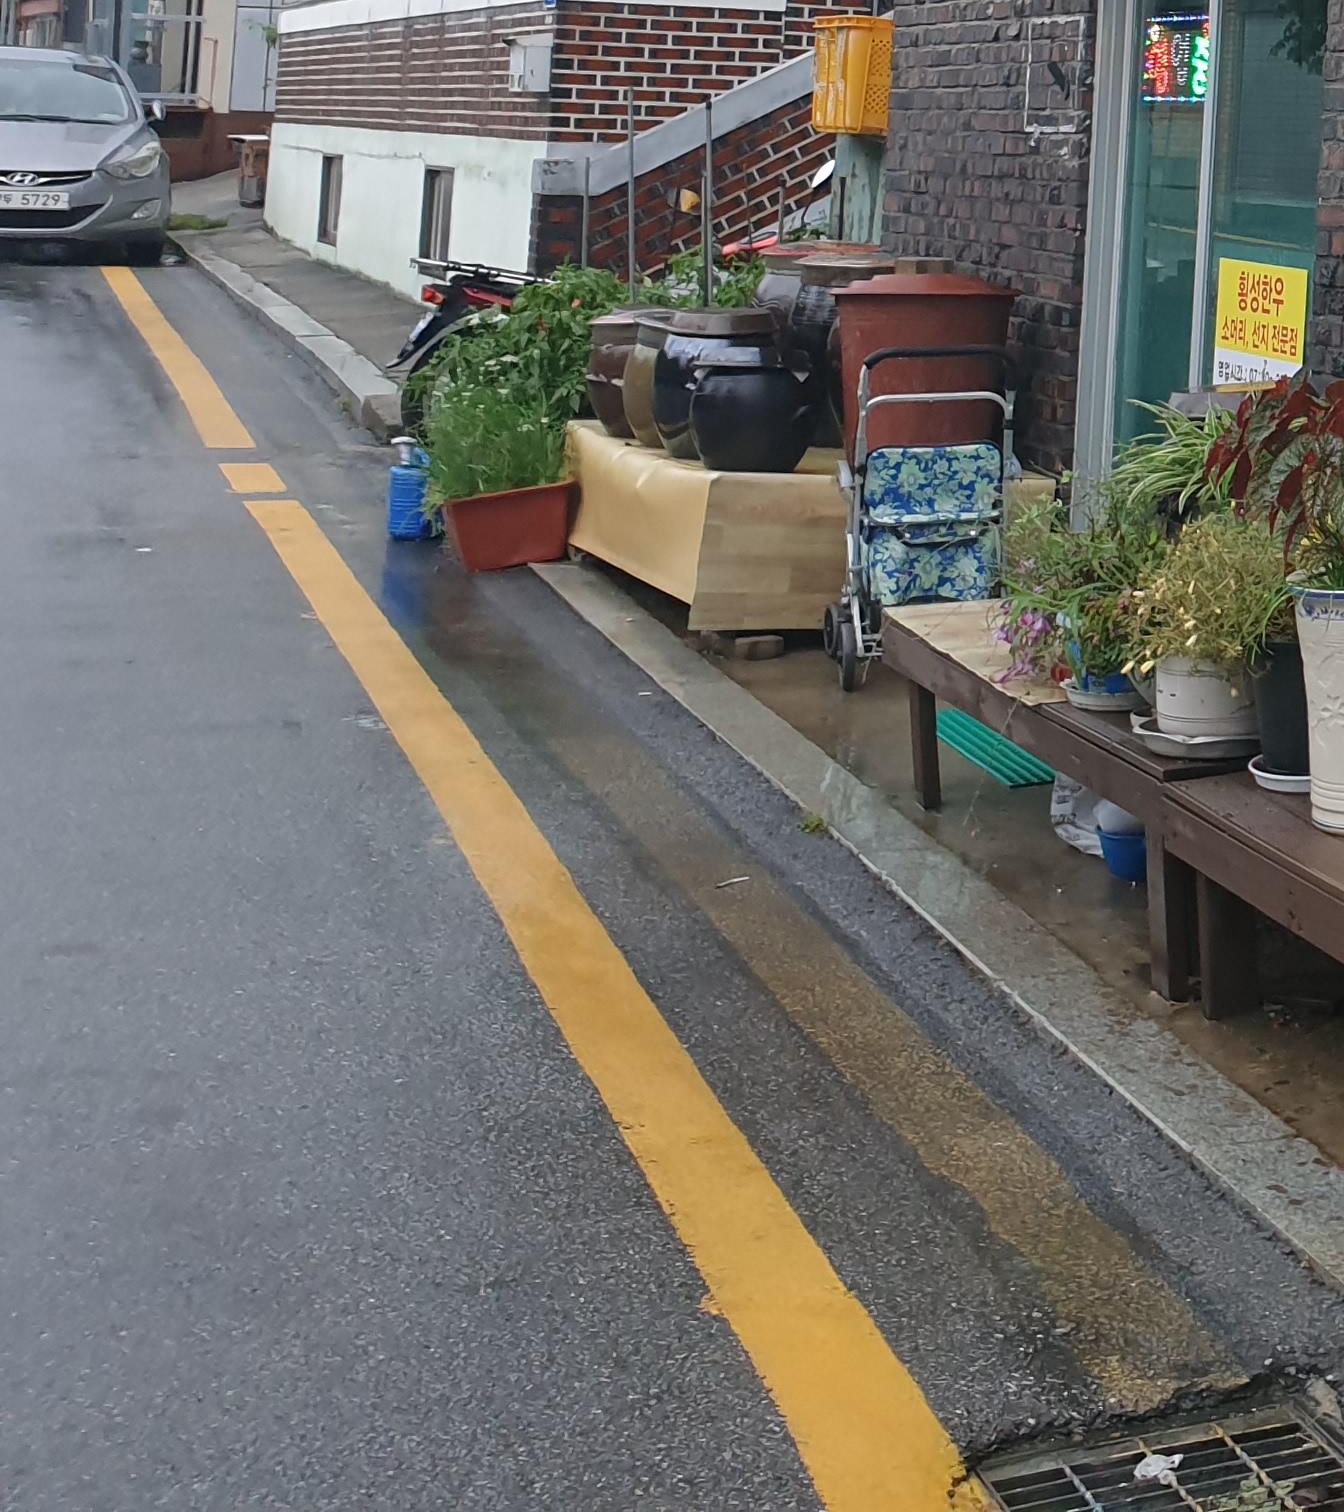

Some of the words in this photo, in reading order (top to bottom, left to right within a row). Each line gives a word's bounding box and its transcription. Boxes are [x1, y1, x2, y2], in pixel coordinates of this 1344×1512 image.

[21, 194, 61, 206] 5729
[1238, 270, 1284, 317] 횡성한우
[1221, 315, 1249, 349] 소머리,
[1252, 320, 1269, 352] 선지
[1272, 324, 1298, 357] 전문점
